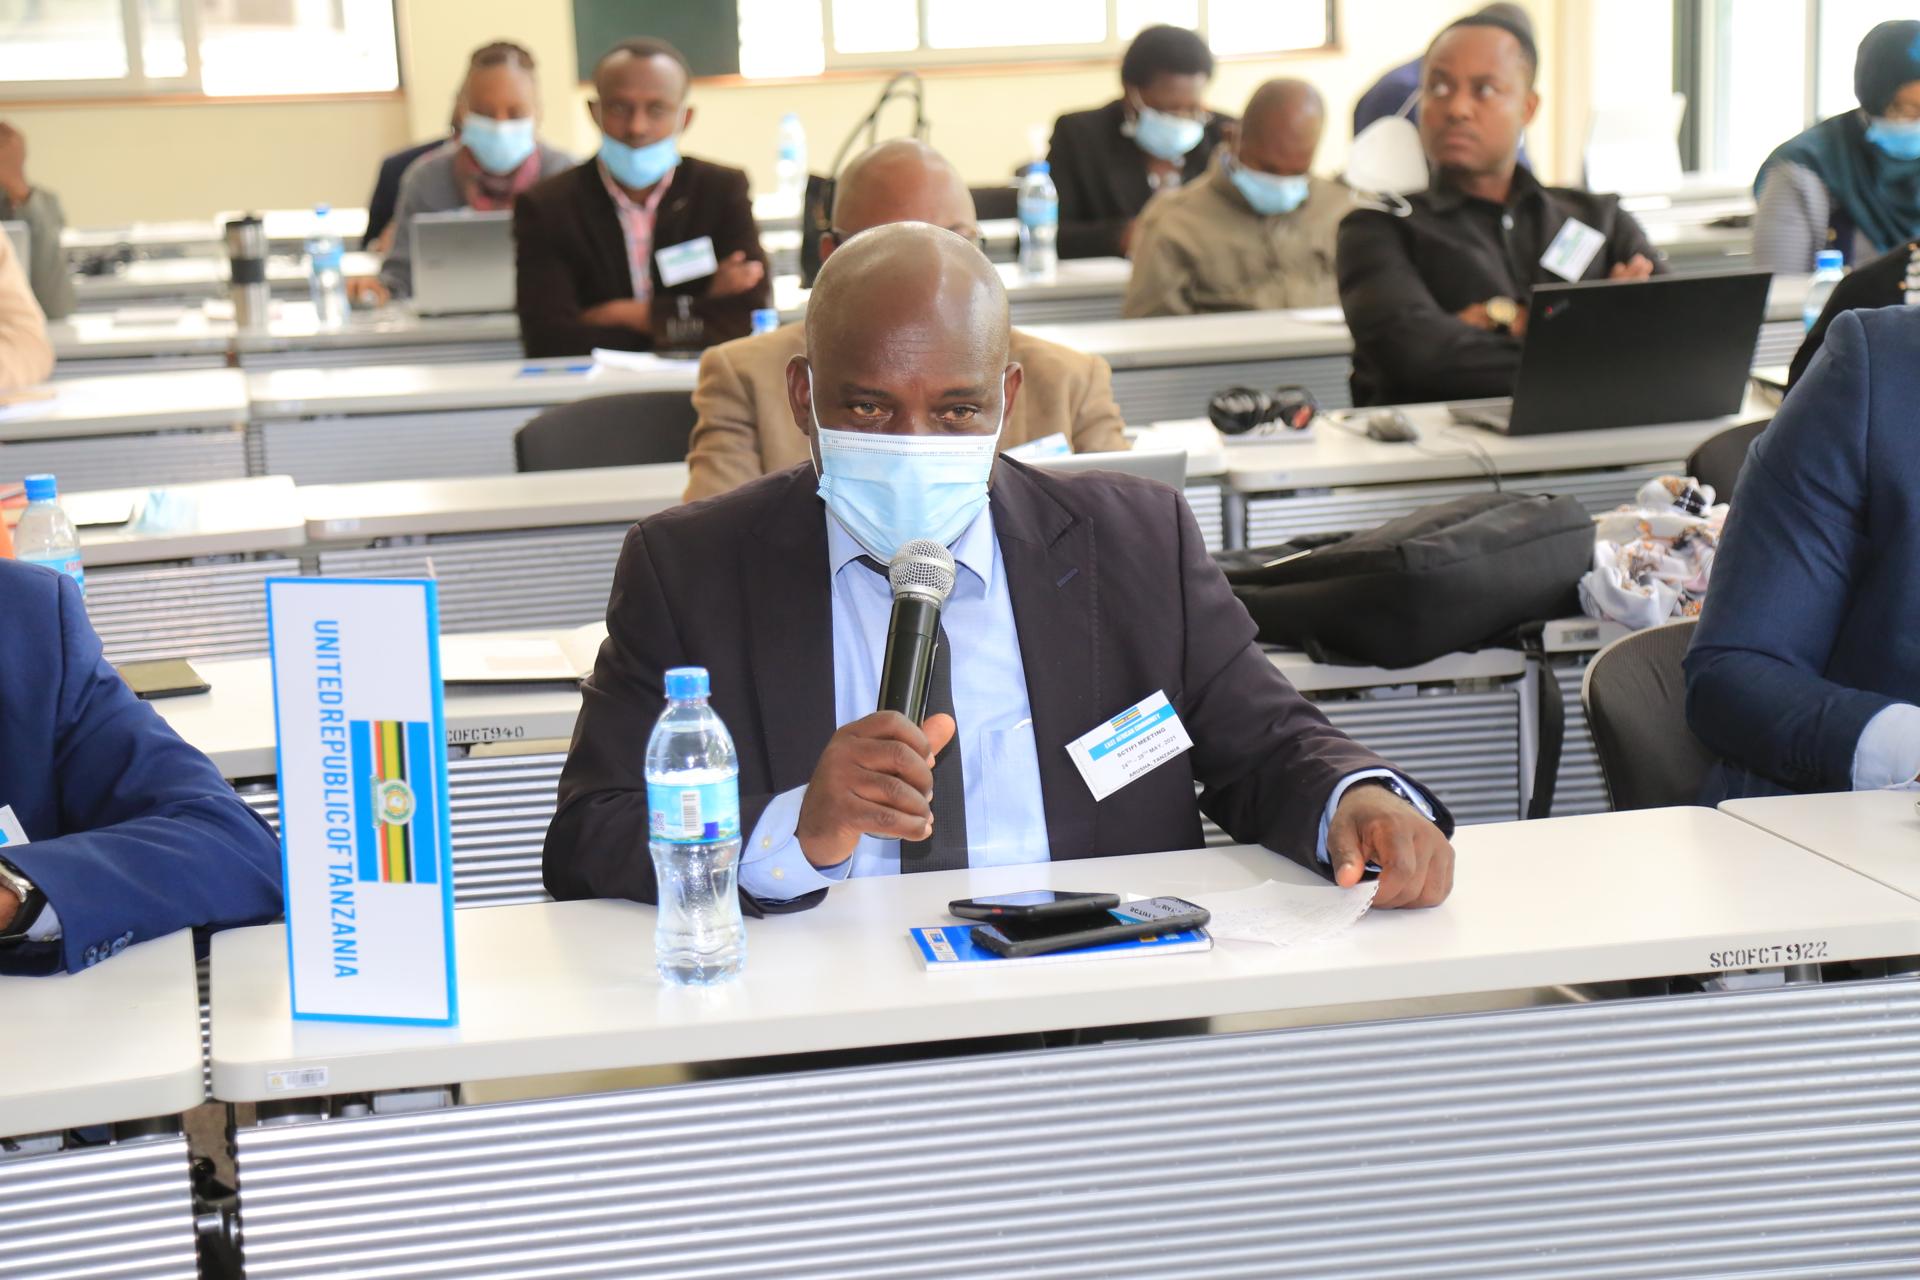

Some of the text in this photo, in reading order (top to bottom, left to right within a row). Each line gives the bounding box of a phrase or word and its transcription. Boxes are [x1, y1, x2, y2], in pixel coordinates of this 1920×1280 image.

[1138, 727, 1166, 746] MEETING
[1153, 746, 1180, 763] TANZANIA
[313, 619, 359, 978] UNITED REPUBLIC OF TANZANIA
